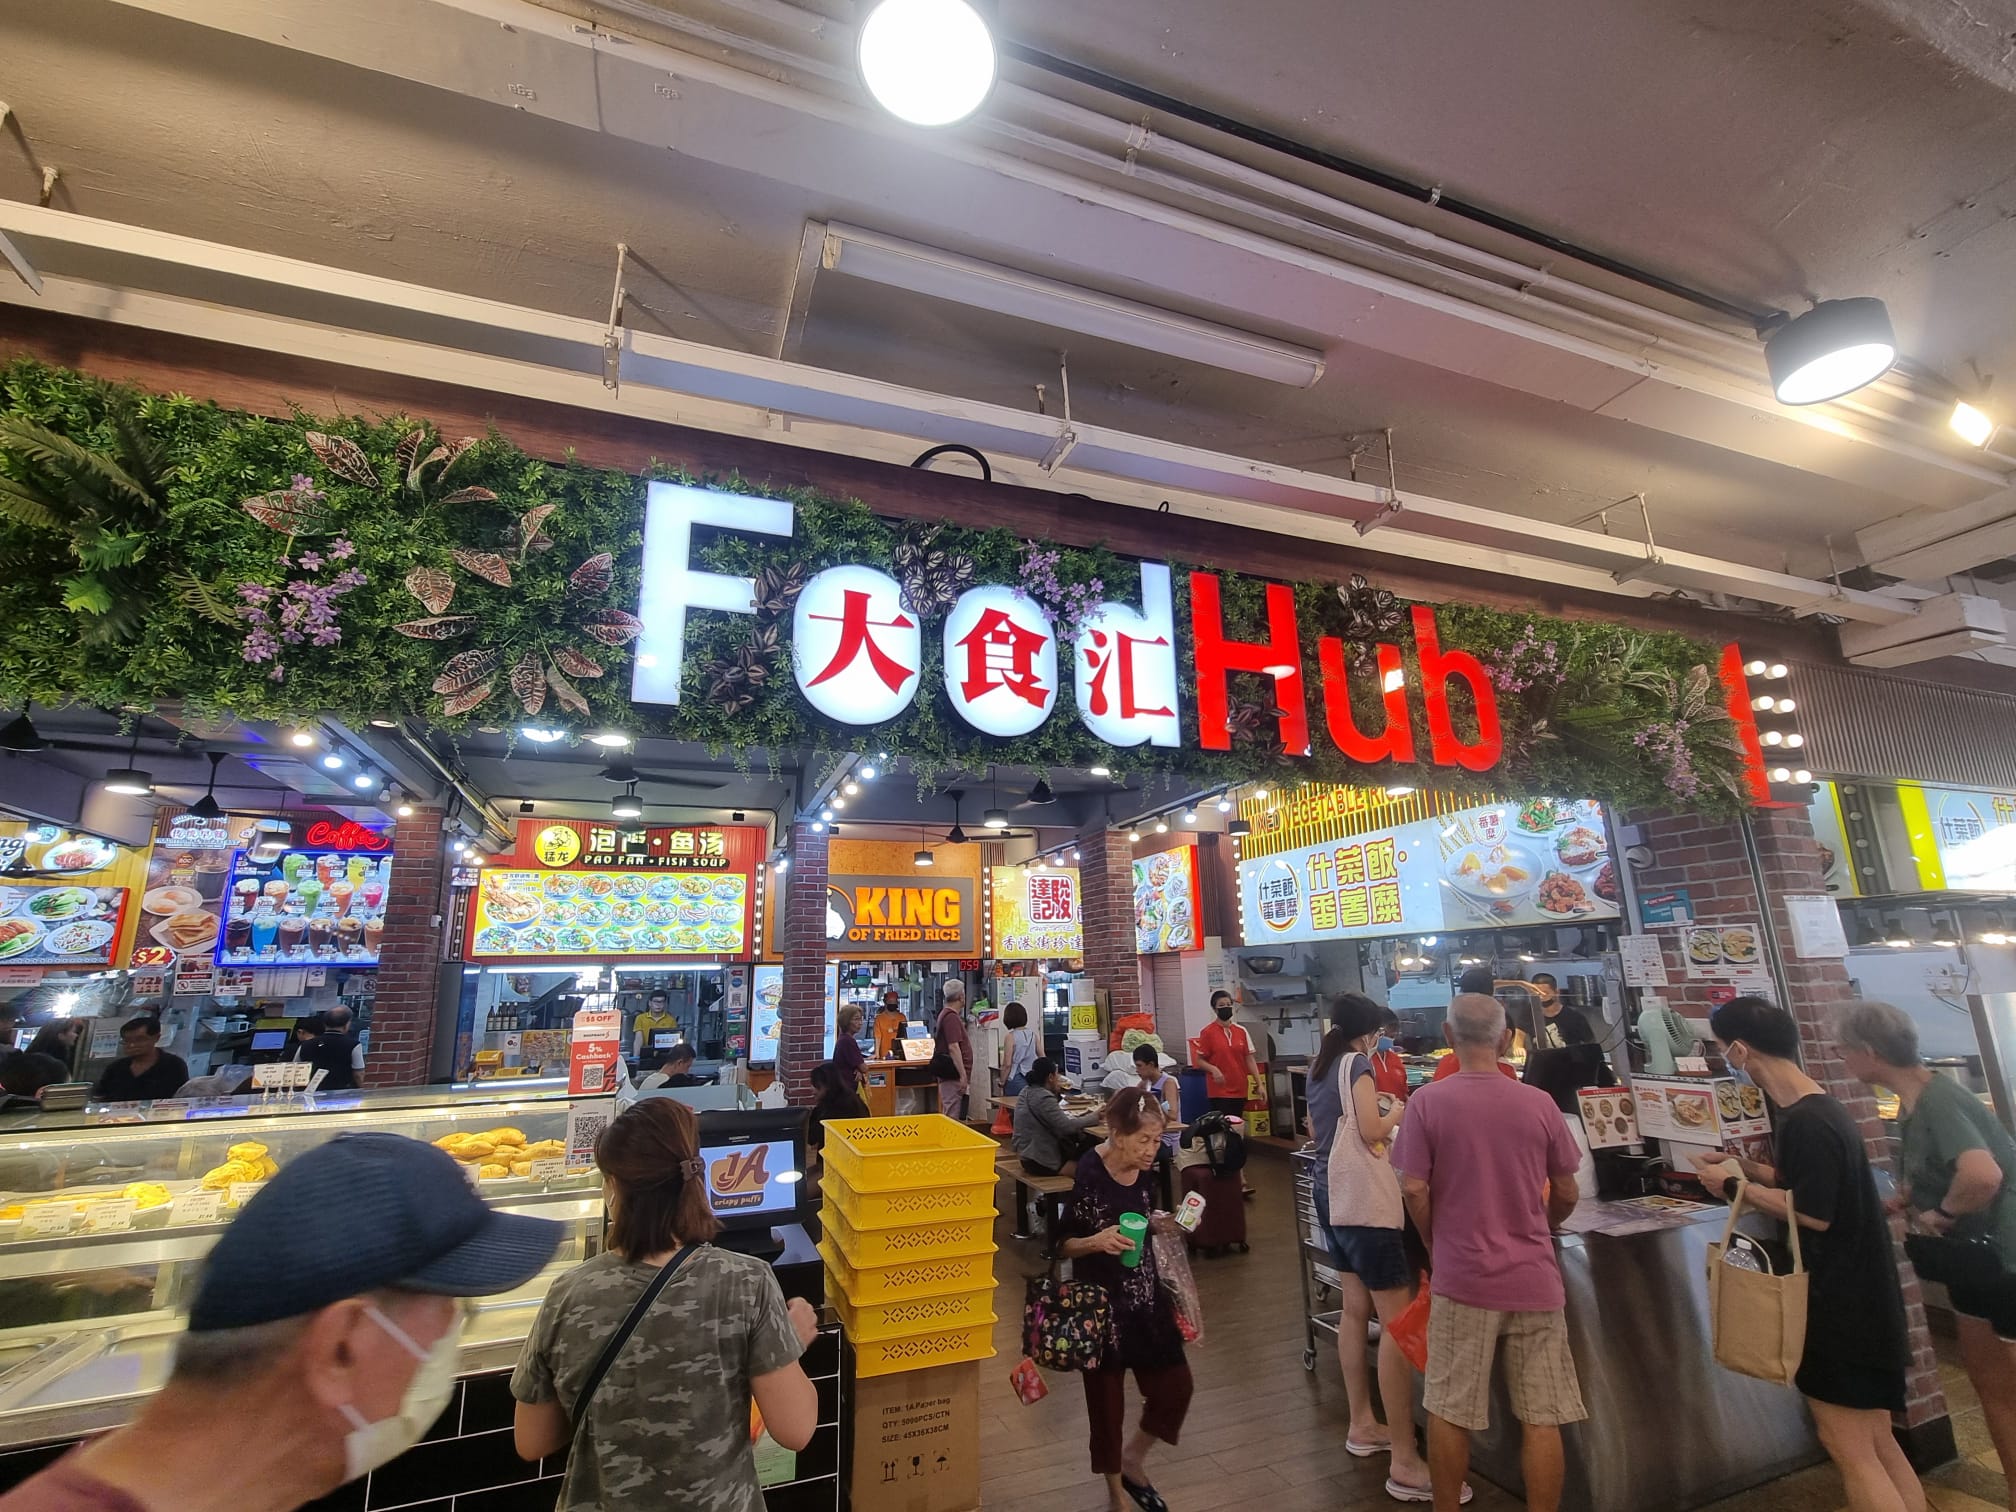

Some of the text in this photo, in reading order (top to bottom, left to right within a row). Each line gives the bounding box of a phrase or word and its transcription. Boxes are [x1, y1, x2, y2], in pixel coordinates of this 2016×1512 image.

[631, 481, 1502, 772] Food Hub
[806, 589, 1176, 719] 大食汇
[1248, 812, 1281, 835] MIXED
[1281, 790, 1365, 828] VEGETABLE
[307, 820, 389, 851] Coffee
[543, 851, 569, 863] 猛龙
[584, 855, 727, 868] PAO FAN FISH SOUP
[855, 887, 960, 926] KING
[848, 928, 960, 941] OF FRIED RICE
[137, 946, 166, 964] $2
[714, 1196, 739, 1206] crispy
